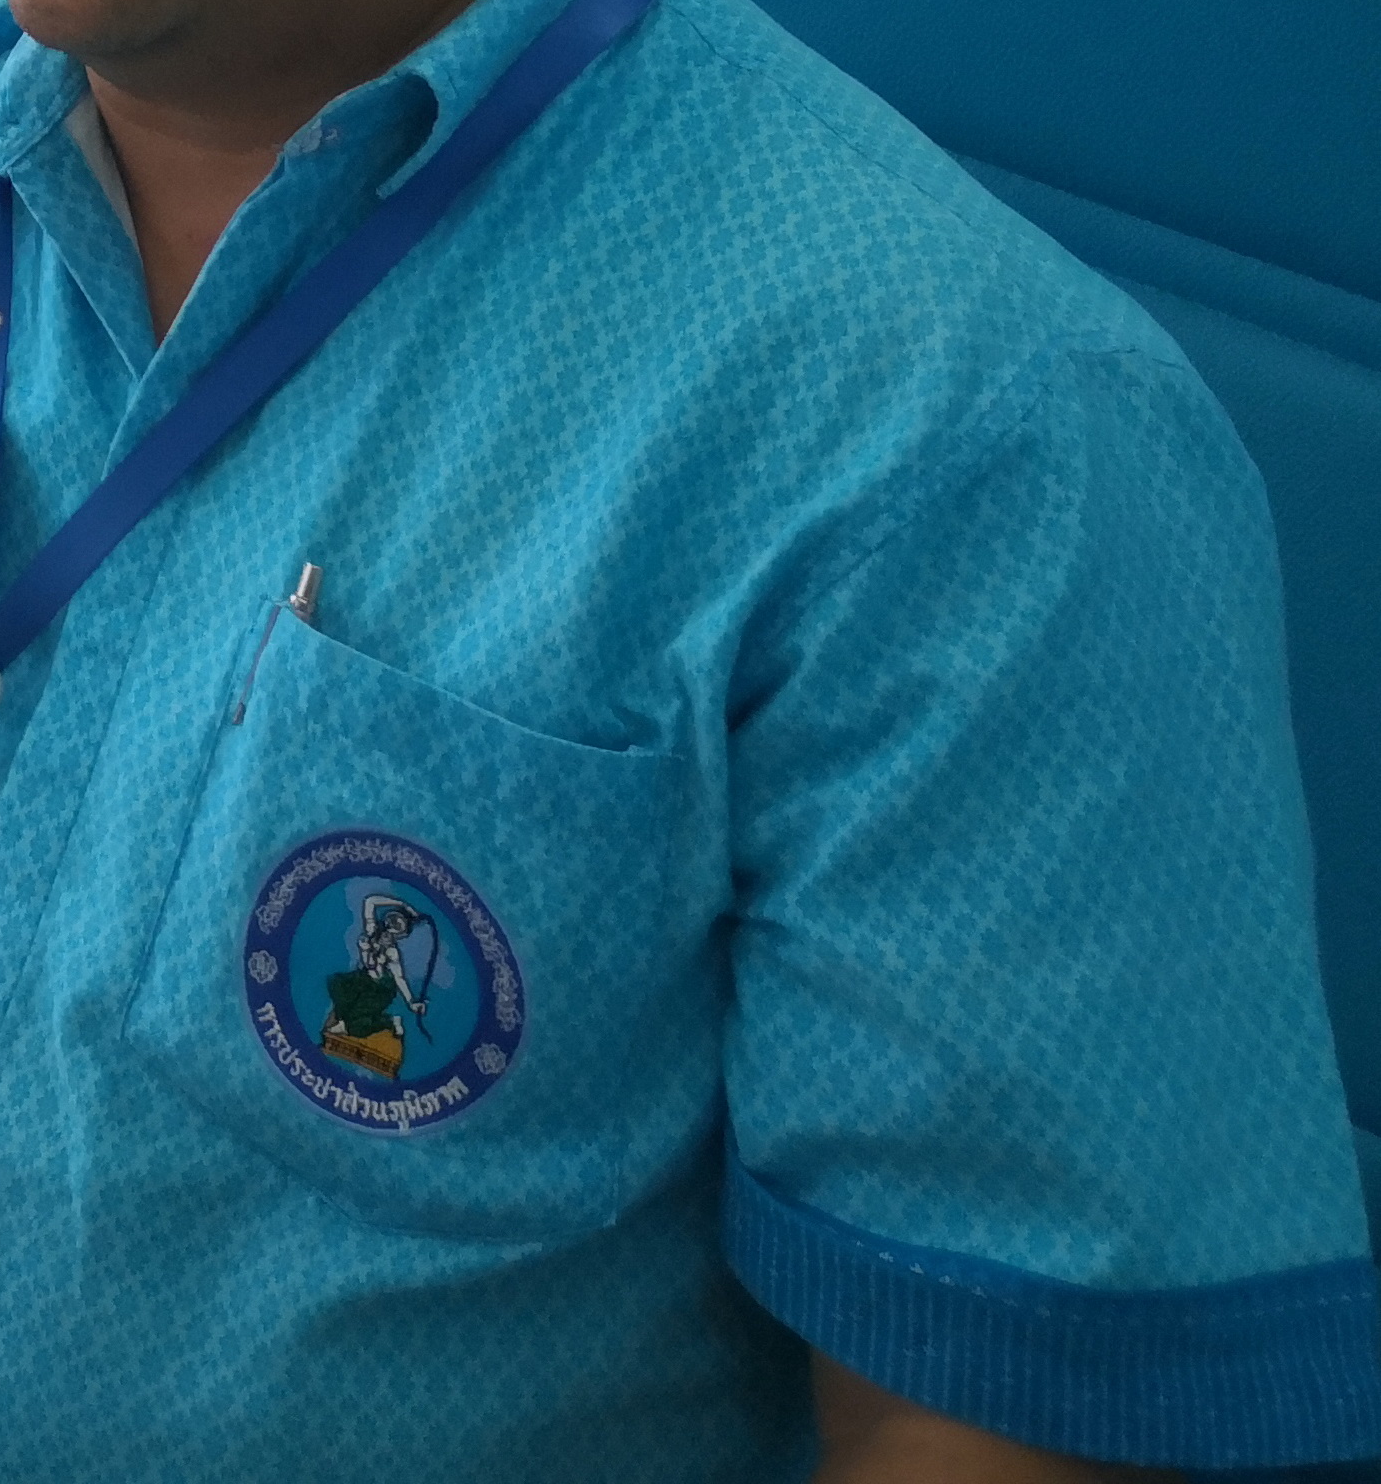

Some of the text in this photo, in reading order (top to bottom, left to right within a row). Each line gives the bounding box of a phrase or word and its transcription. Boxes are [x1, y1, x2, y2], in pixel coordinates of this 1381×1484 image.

[256, 1001, 469, 1136] การประปาส่วนภูมิภาค
